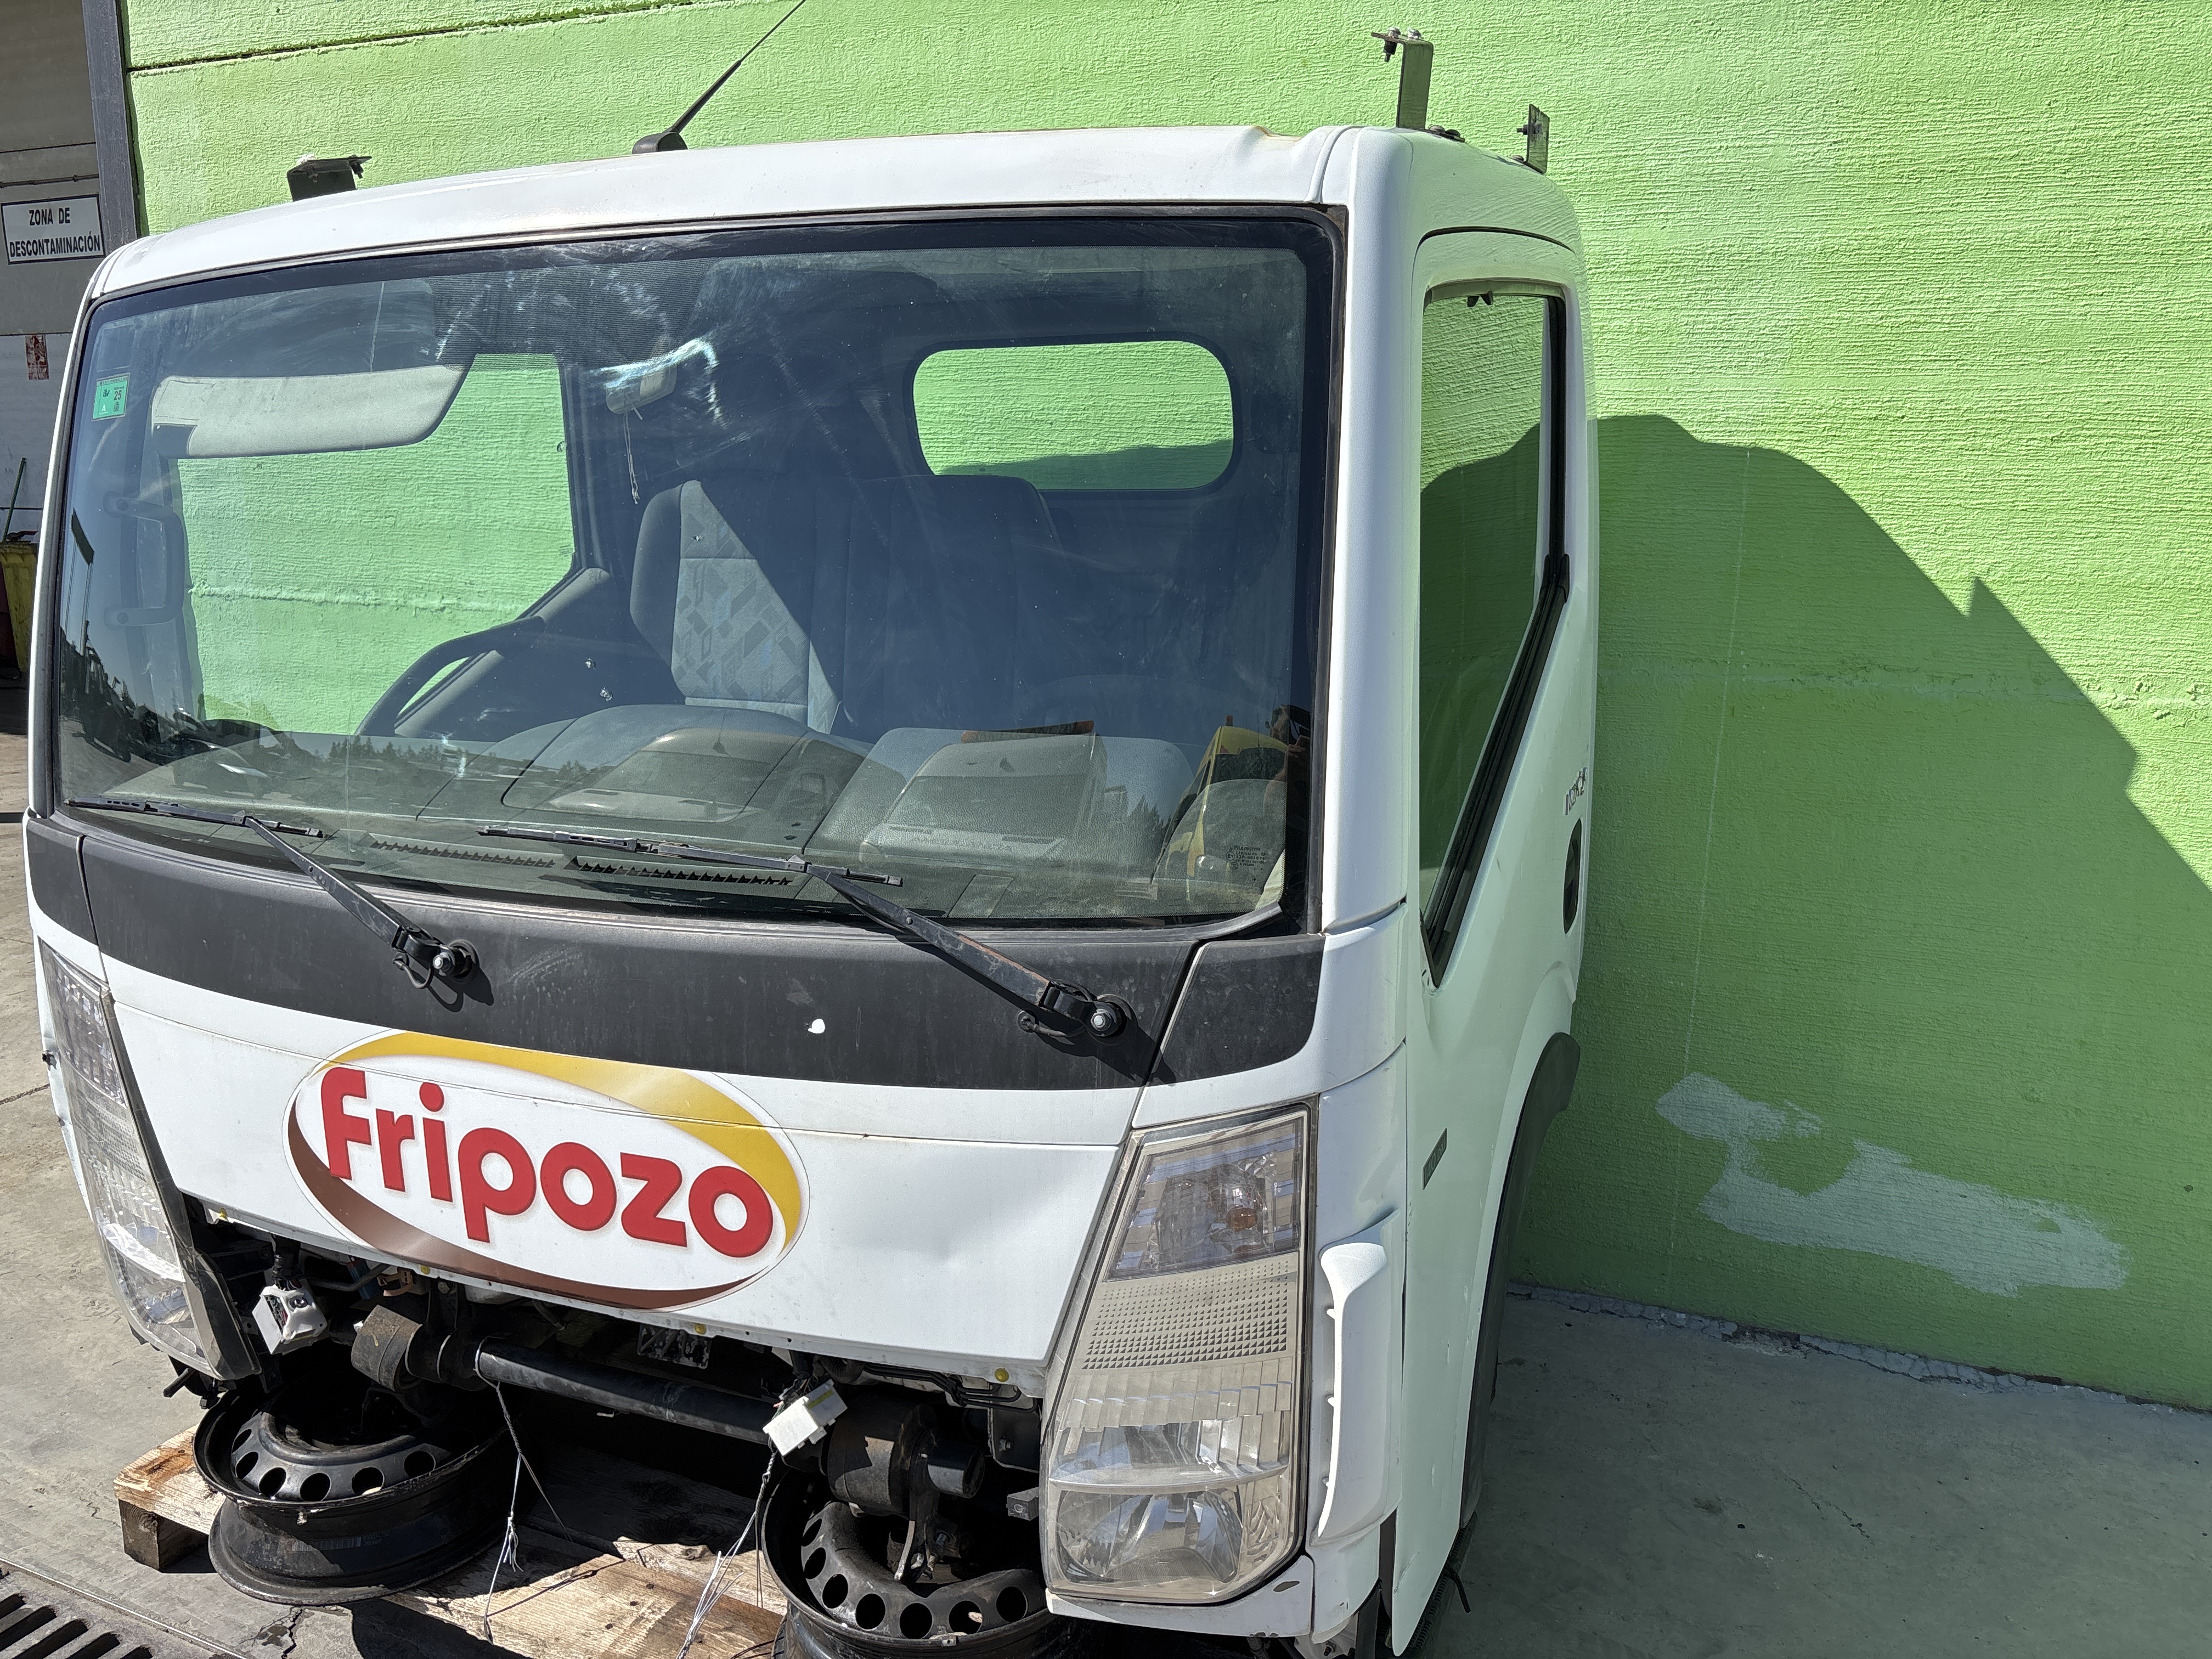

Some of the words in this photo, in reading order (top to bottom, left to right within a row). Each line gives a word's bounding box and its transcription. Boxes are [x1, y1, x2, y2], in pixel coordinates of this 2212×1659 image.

[29, 208, 53, 225] ZONA
[59, 207, 71, 224] DE
[10, 232, 100, 257] DESCONTAMINACIÓN
